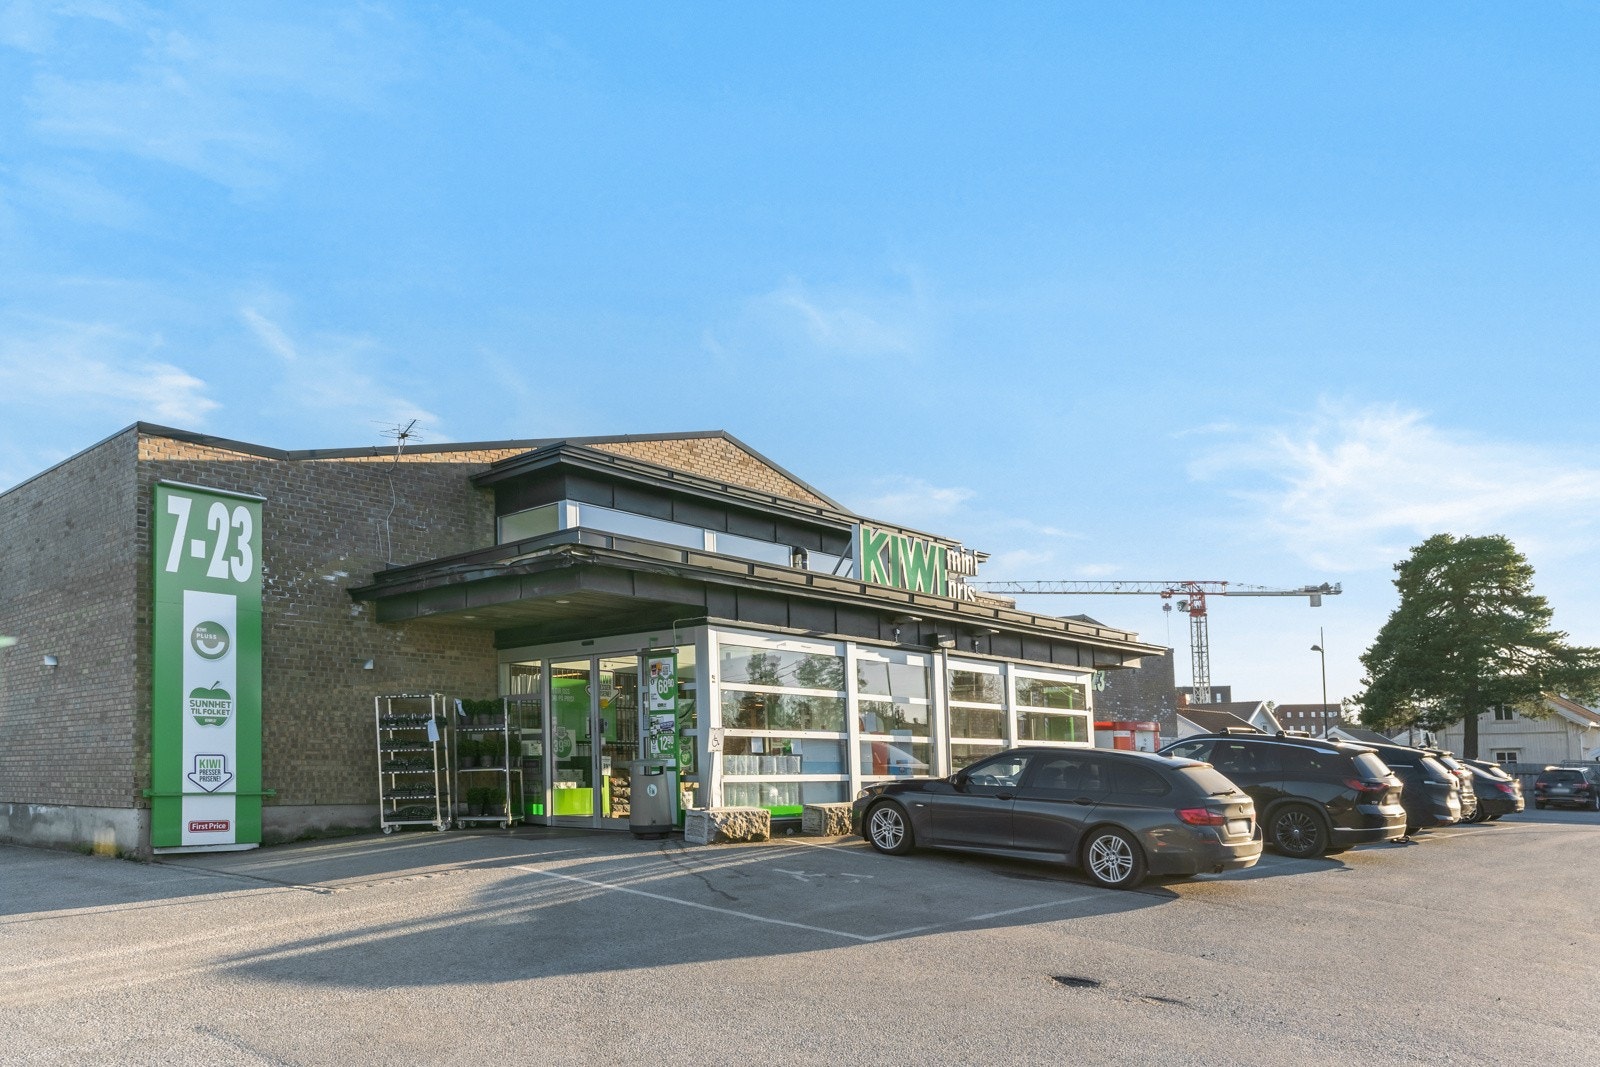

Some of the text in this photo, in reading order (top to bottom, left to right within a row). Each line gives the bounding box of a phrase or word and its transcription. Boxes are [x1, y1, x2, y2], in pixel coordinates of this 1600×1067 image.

[165, 495, 253, 583] 7-23
[859, 524, 947, 597] KIWI
[190, 700, 231, 708] SUNNHET
[199, 759, 221, 769] KIWI
[191, 822, 208, 830] First
